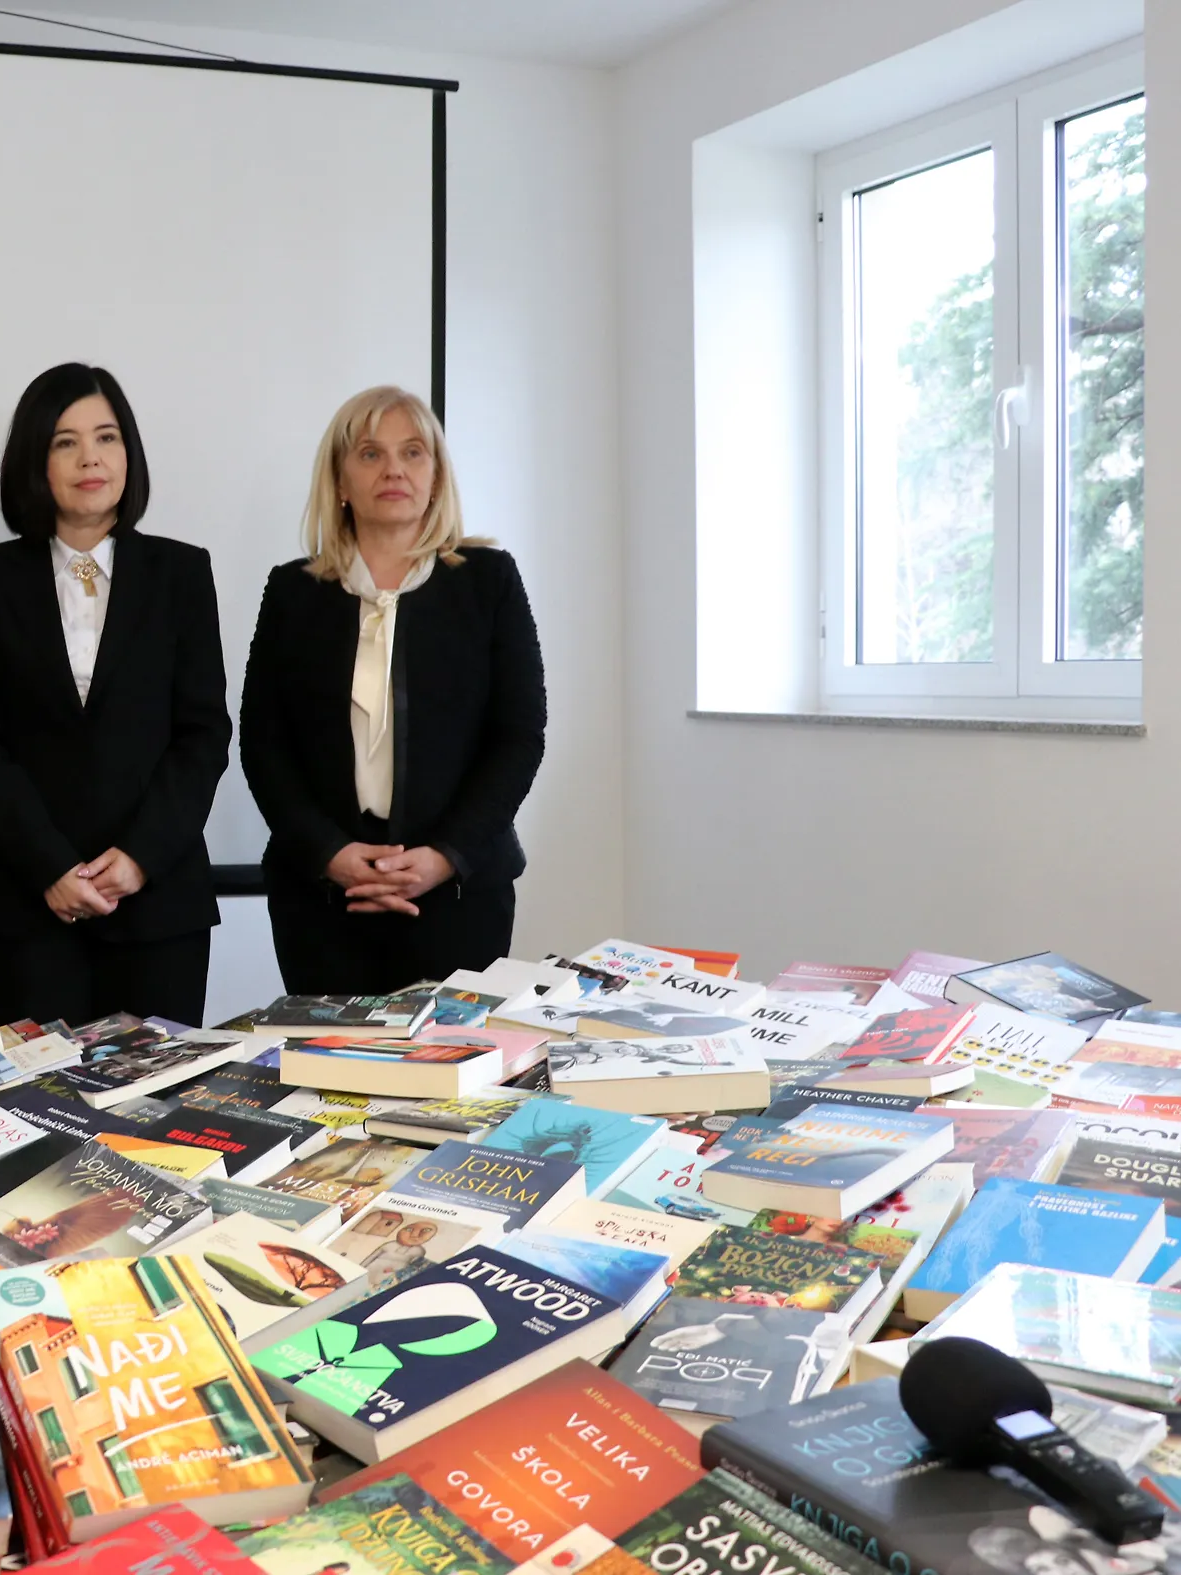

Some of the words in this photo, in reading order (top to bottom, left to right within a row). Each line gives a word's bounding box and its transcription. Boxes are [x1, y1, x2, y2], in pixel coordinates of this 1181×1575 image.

[661, 974, 738, 999] KANT
[751, 1007, 809, 1027] MILL
[793, 1089, 852, 1102] HEATHER
[857, 1095, 912, 1107] CHAVEZ
[166, 1129, 249, 1154] BULGAKOV
[797, 1121, 912, 1143] NIKOME
[455, 1155, 533, 1184] JOHN
[1094, 1153, 1181, 1176] DOUGL
[1104, 1167, 1181, 1188] STUAR
[77, 1154, 153, 1203] JOHANNA
[154, 1197, 184, 1219] MO
[278, 1175, 375, 1201] MJESTO
[418, 1167, 540, 1206] GRISHAM
[387, 1197, 417, 1210] Tatjana
[418, 1203, 458, 1216] Gromača
[445, 1257, 591, 1323] ATWOOD
[541, 1276, 604, 1309] MARGARET
[67, 1323, 188, 1389] NAĐI
[676, 1352, 701, 1361] EDI
[705, 1355, 753, 1367] MATIĆ
[273, 1342, 407, 1415] SVJEDOČANSTVA
[107, 1371, 187, 1432] ME
[583, 1386, 614, 1411] Allan
[619, 1411, 665, 1449] Barbara
[175, 1444, 244, 1467] ACIMAN
[565, 1412, 652, 1482] VELIKA
[511, 1443, 592, 1511] ŠKOLA
[832, 1457, 873, 1478] O
[446, 1469, 545, 1551] GOVORA
[719, 1499, 774, 1538] MATTIAS
[370, 1503, 459, 1573] KNJIGA
[790, 1492, 881, 1563] KNJIGA
